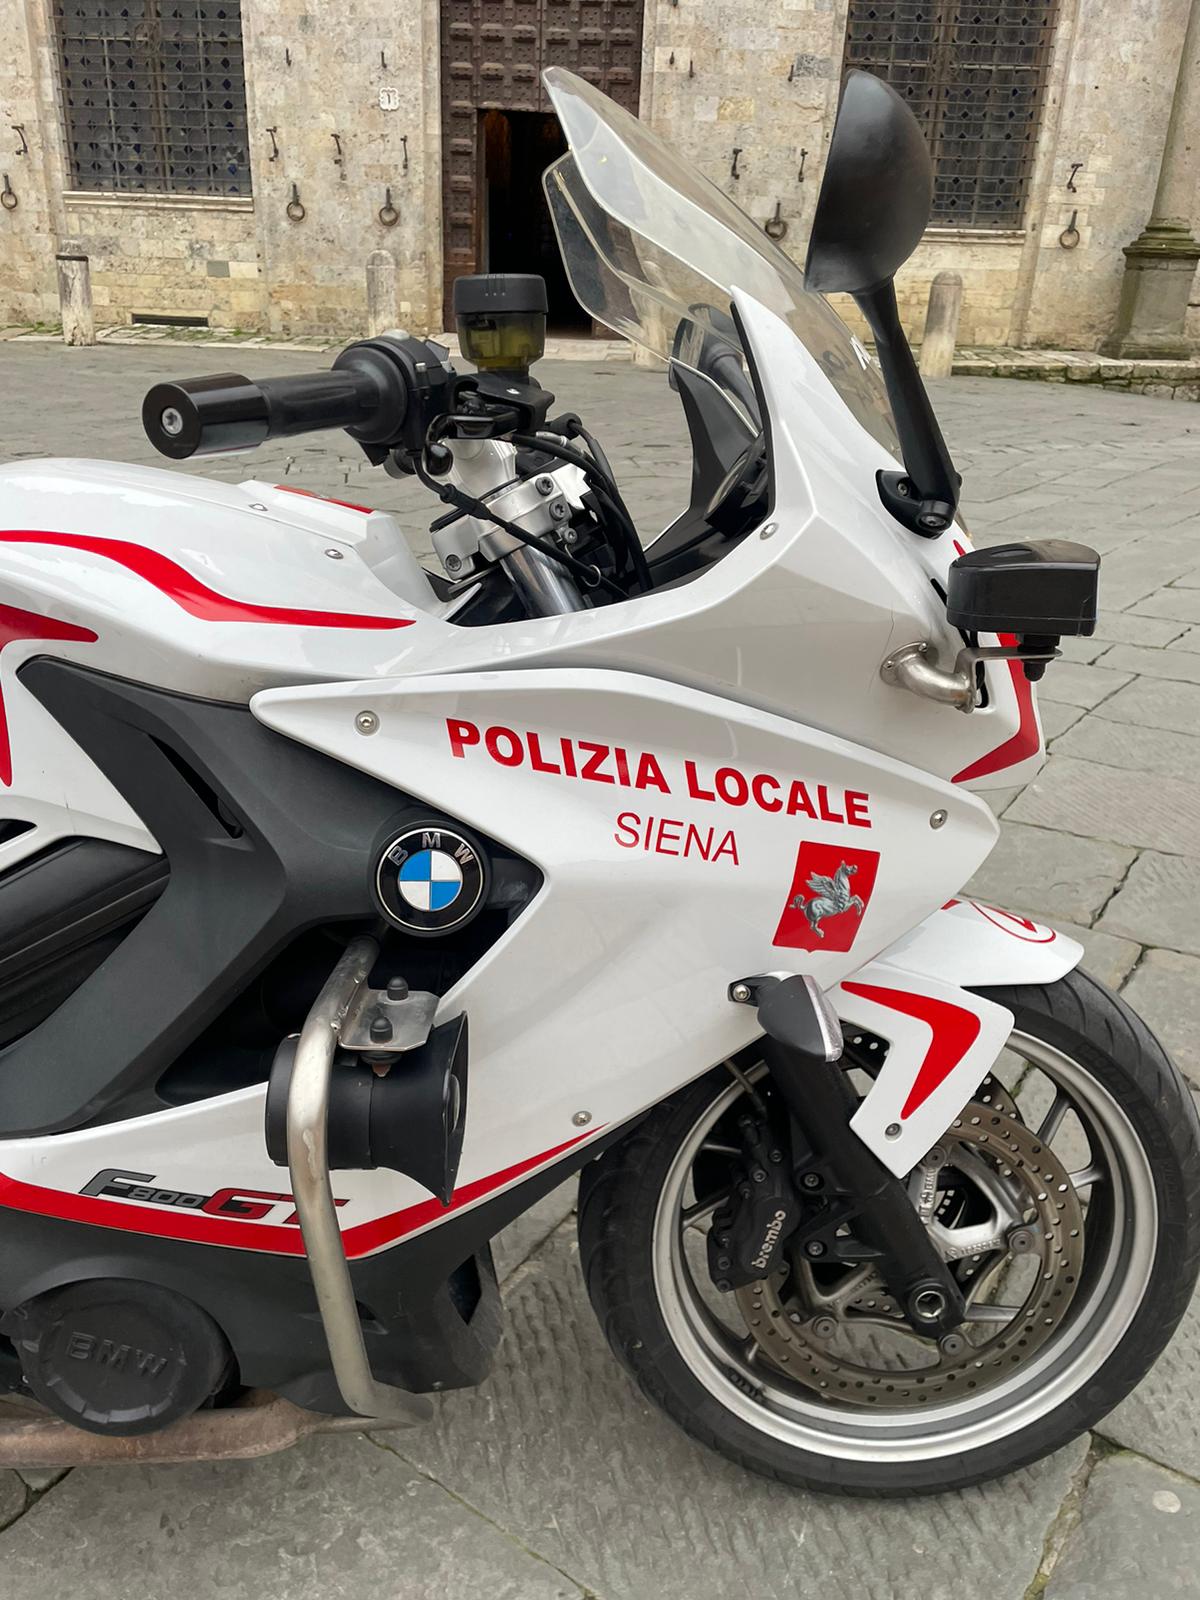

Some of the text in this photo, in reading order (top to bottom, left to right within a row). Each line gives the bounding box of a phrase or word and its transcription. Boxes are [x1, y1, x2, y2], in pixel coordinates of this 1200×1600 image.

[446, 718, 873, 830] POLIZIA LOCALE
[387, 832, 475, 867] BMW
[613, 811, 740, 867] SIENA
[751, 1210, 786, 1269] brembo
[66, 1331, 168, 1378] BMW
